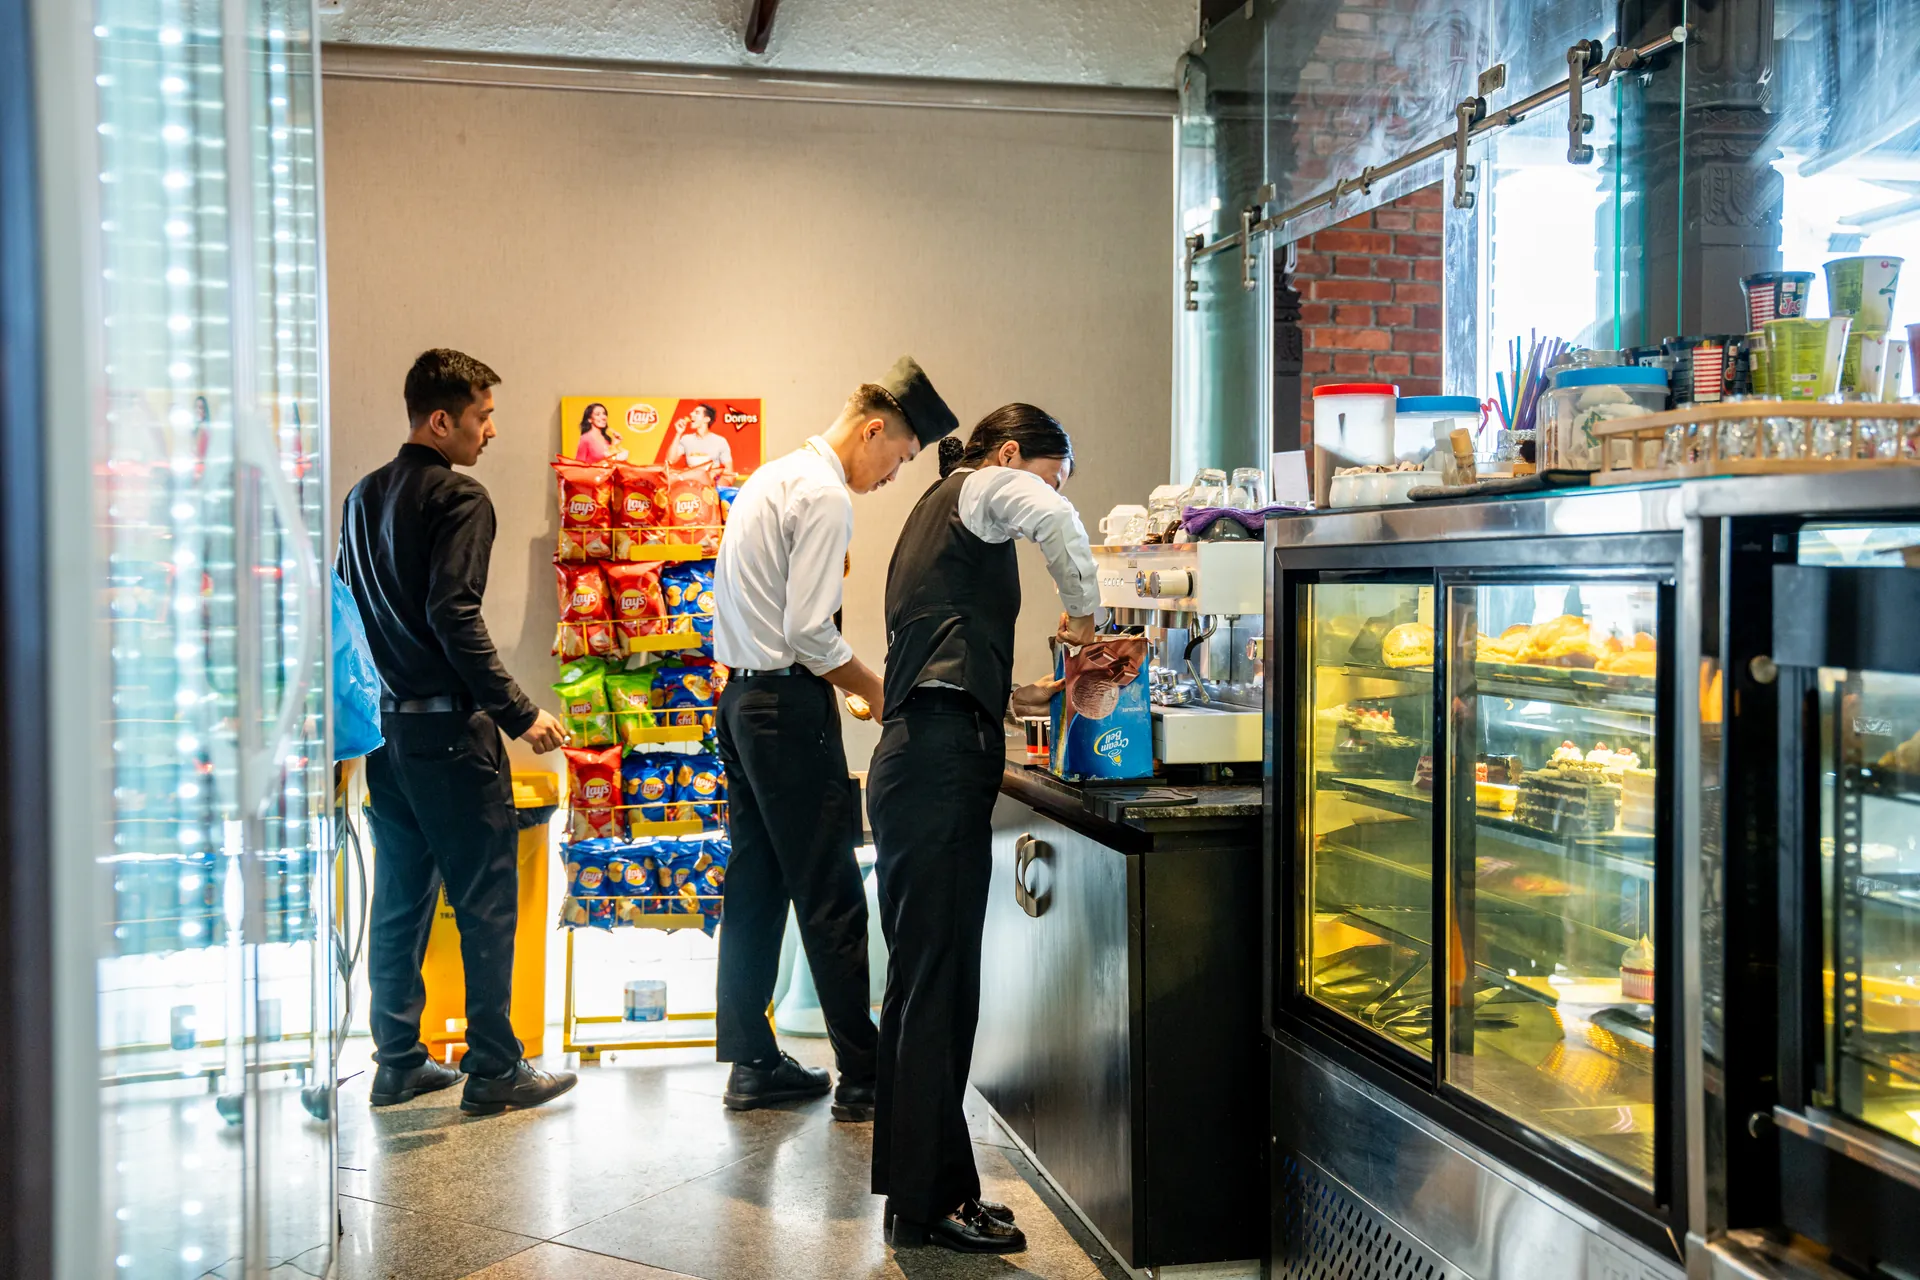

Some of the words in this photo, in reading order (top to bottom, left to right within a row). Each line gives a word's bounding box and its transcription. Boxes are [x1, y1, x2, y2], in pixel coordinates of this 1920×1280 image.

[629, 408, 657, 425] Lay's
[724, 413, 758, 424] Doritos
[569, 501, 595, 516] Lay's
[627, 498, 650, 513] Lay's
[676, 497, 700, 514] Lay's
[572, 591, 597, 607] Lay's
[621, 595, 646, 610] Lay's
[570, 702, 592, 715] Lay's
[1105, 730, 1122, 744] Bell
[1101, 738, 1129, 752] Cream
[586, 783, 610, 799] Lay's
[643, 783, 665, 795] Lay's
[580, 869, 604, 884] Lay's
